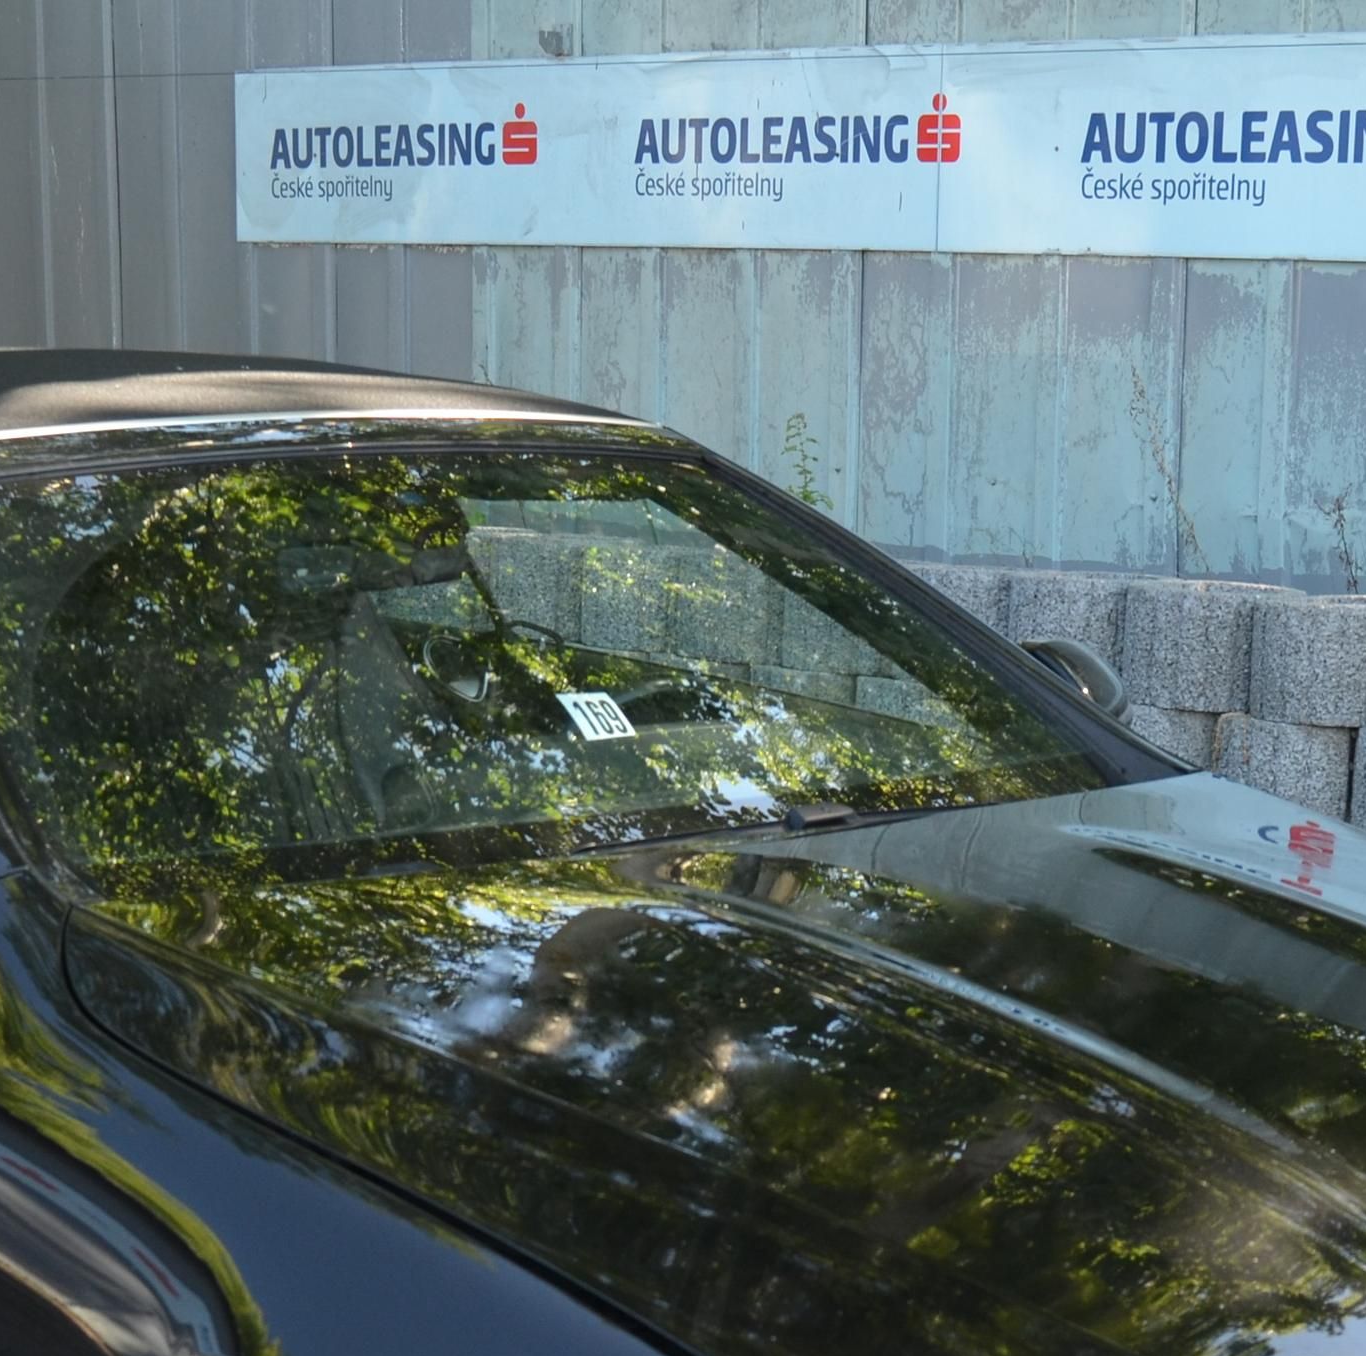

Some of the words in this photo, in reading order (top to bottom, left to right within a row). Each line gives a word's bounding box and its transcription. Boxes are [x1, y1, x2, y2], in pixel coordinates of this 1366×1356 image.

[270, 121, 495, 169] AUTOLEASING
[634, 114, 909, 164] AUTOLEASING
[271, 172, 314, 199] České
[317, 174, 393, 202] spořitelny
[635, 167, 686, 197] České
[691, 170, 784, 203] spořitelny
[1081, 167, 1144, 200] České
[1150, 172, 1266, 207] spořitelny
[572, 700, 628, 736] 169
